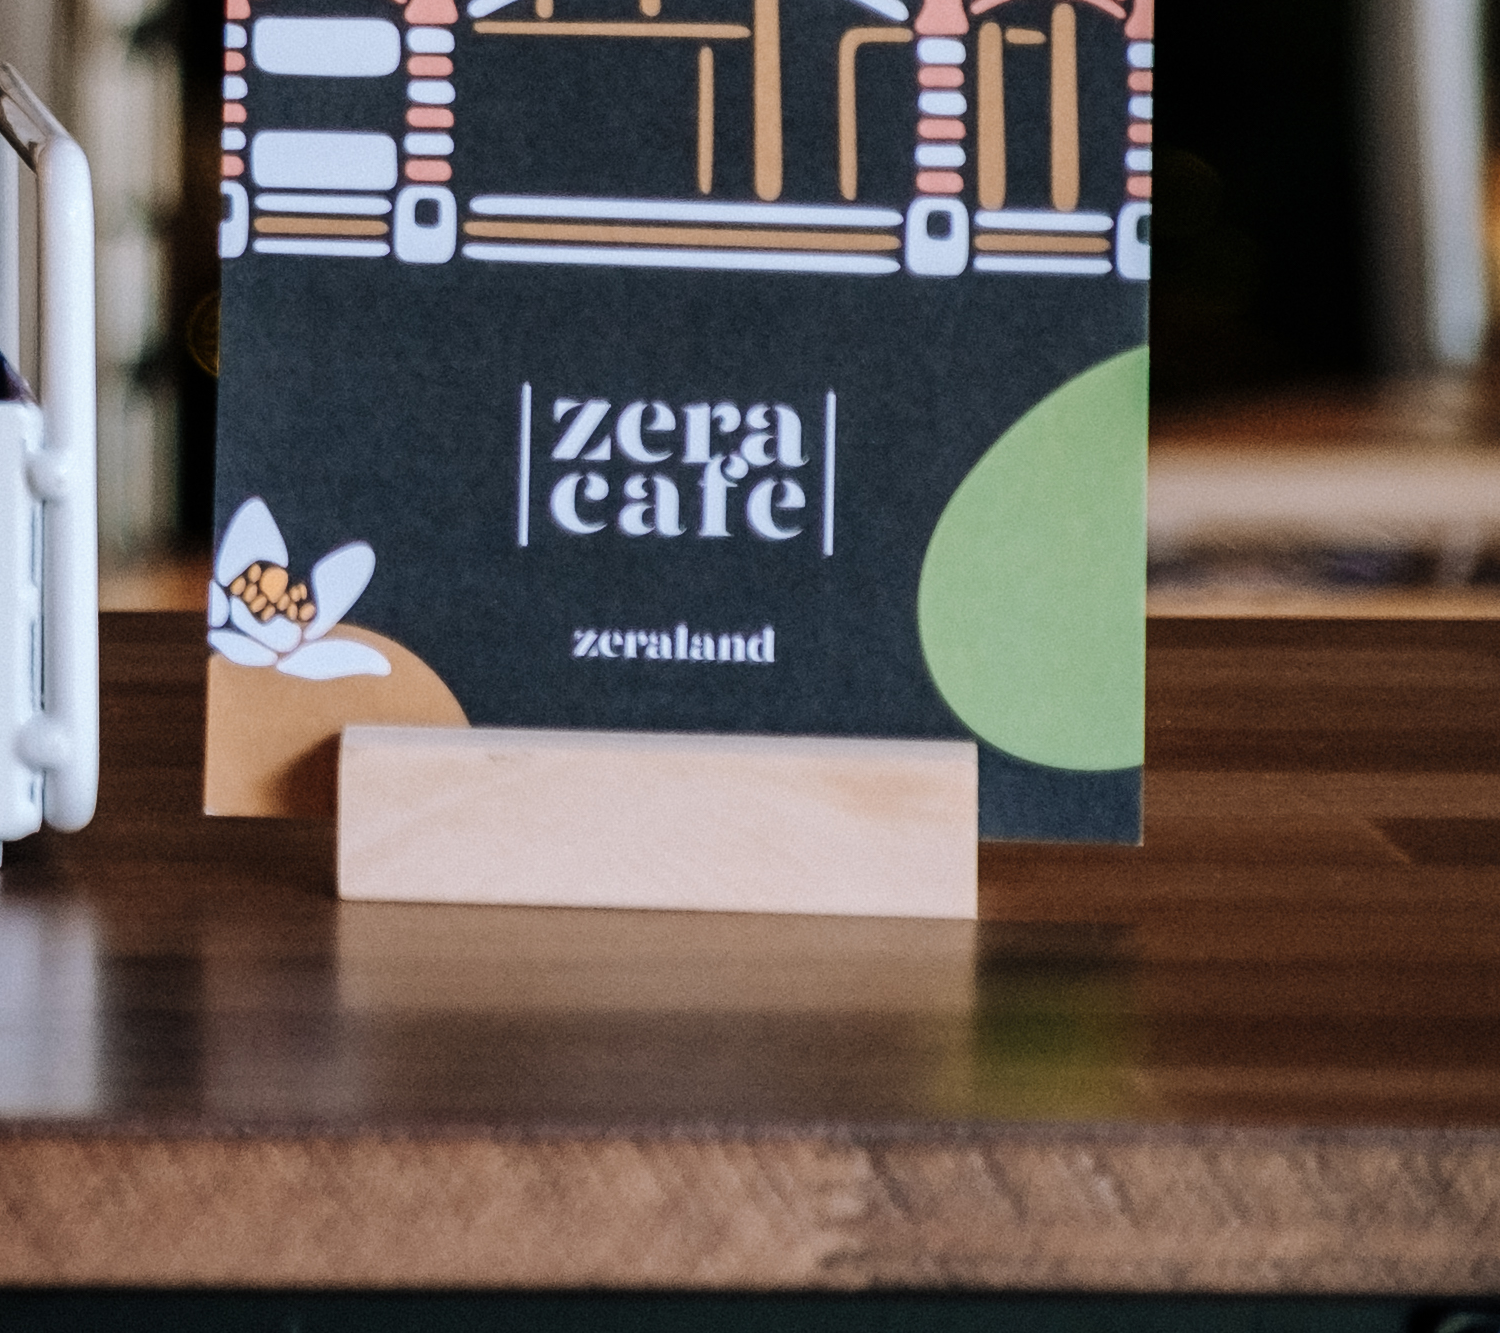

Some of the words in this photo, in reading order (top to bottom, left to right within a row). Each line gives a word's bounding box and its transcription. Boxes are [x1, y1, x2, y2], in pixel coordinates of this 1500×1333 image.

[553, 396, 808, 466] zera
[550, 453, 808, 539] cafe
[572, 623, 776, 663] zeraland
